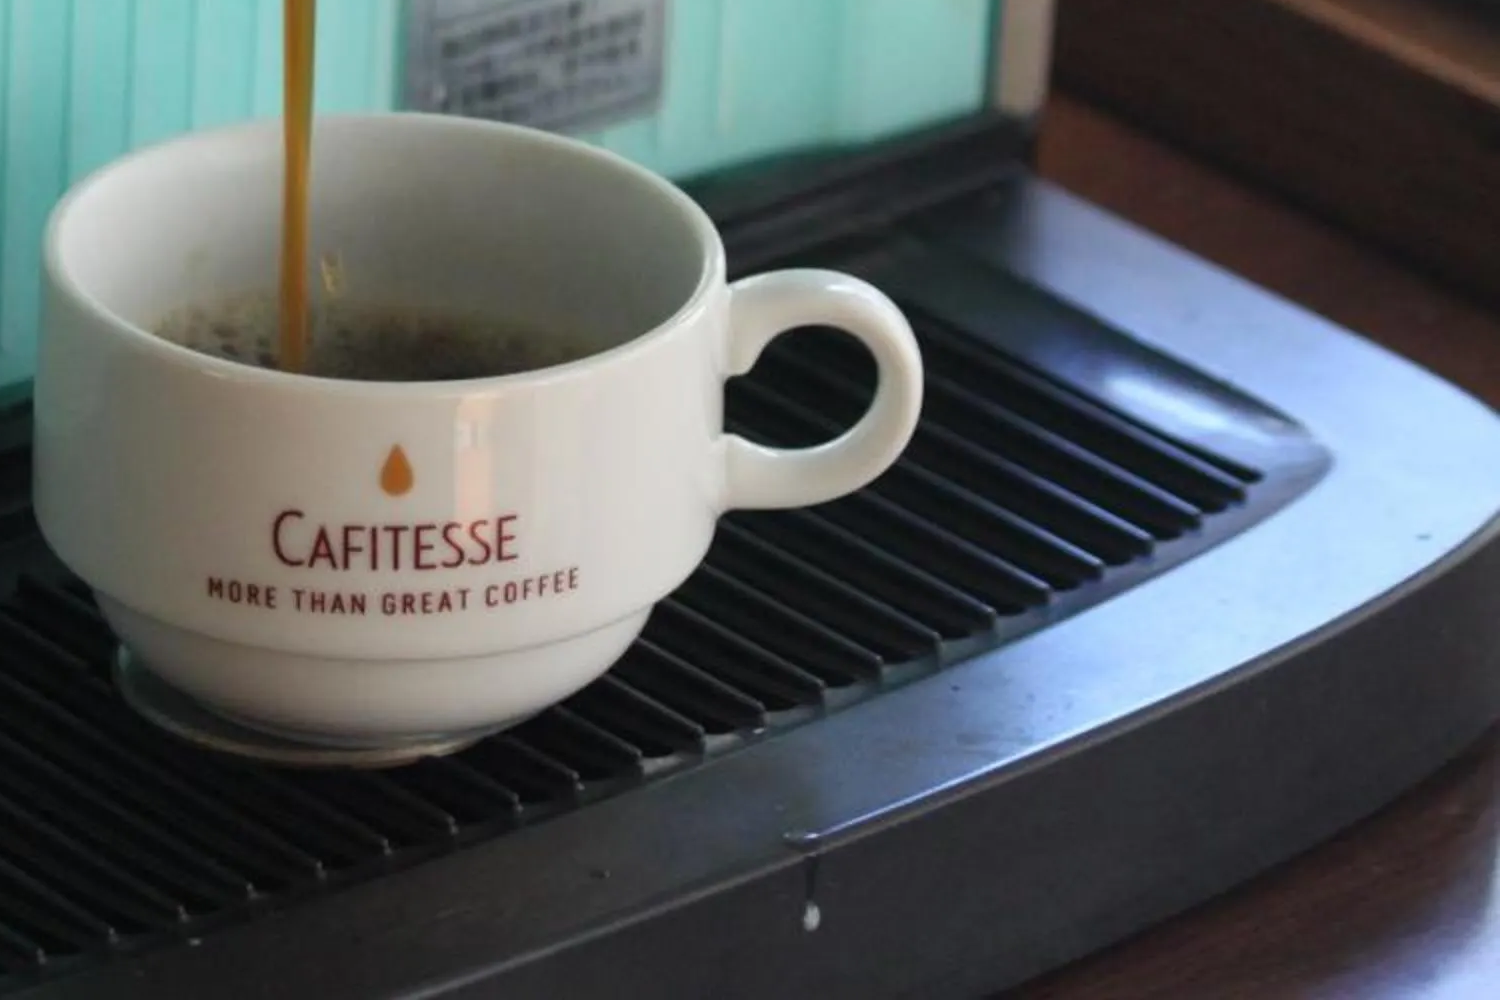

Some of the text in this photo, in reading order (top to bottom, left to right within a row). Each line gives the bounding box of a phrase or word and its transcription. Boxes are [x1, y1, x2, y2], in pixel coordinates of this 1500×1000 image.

[271, 509, 520, 571] CAFITESSE
[207, 566, 581, 616] MORE THAN GREAT COFFEE
